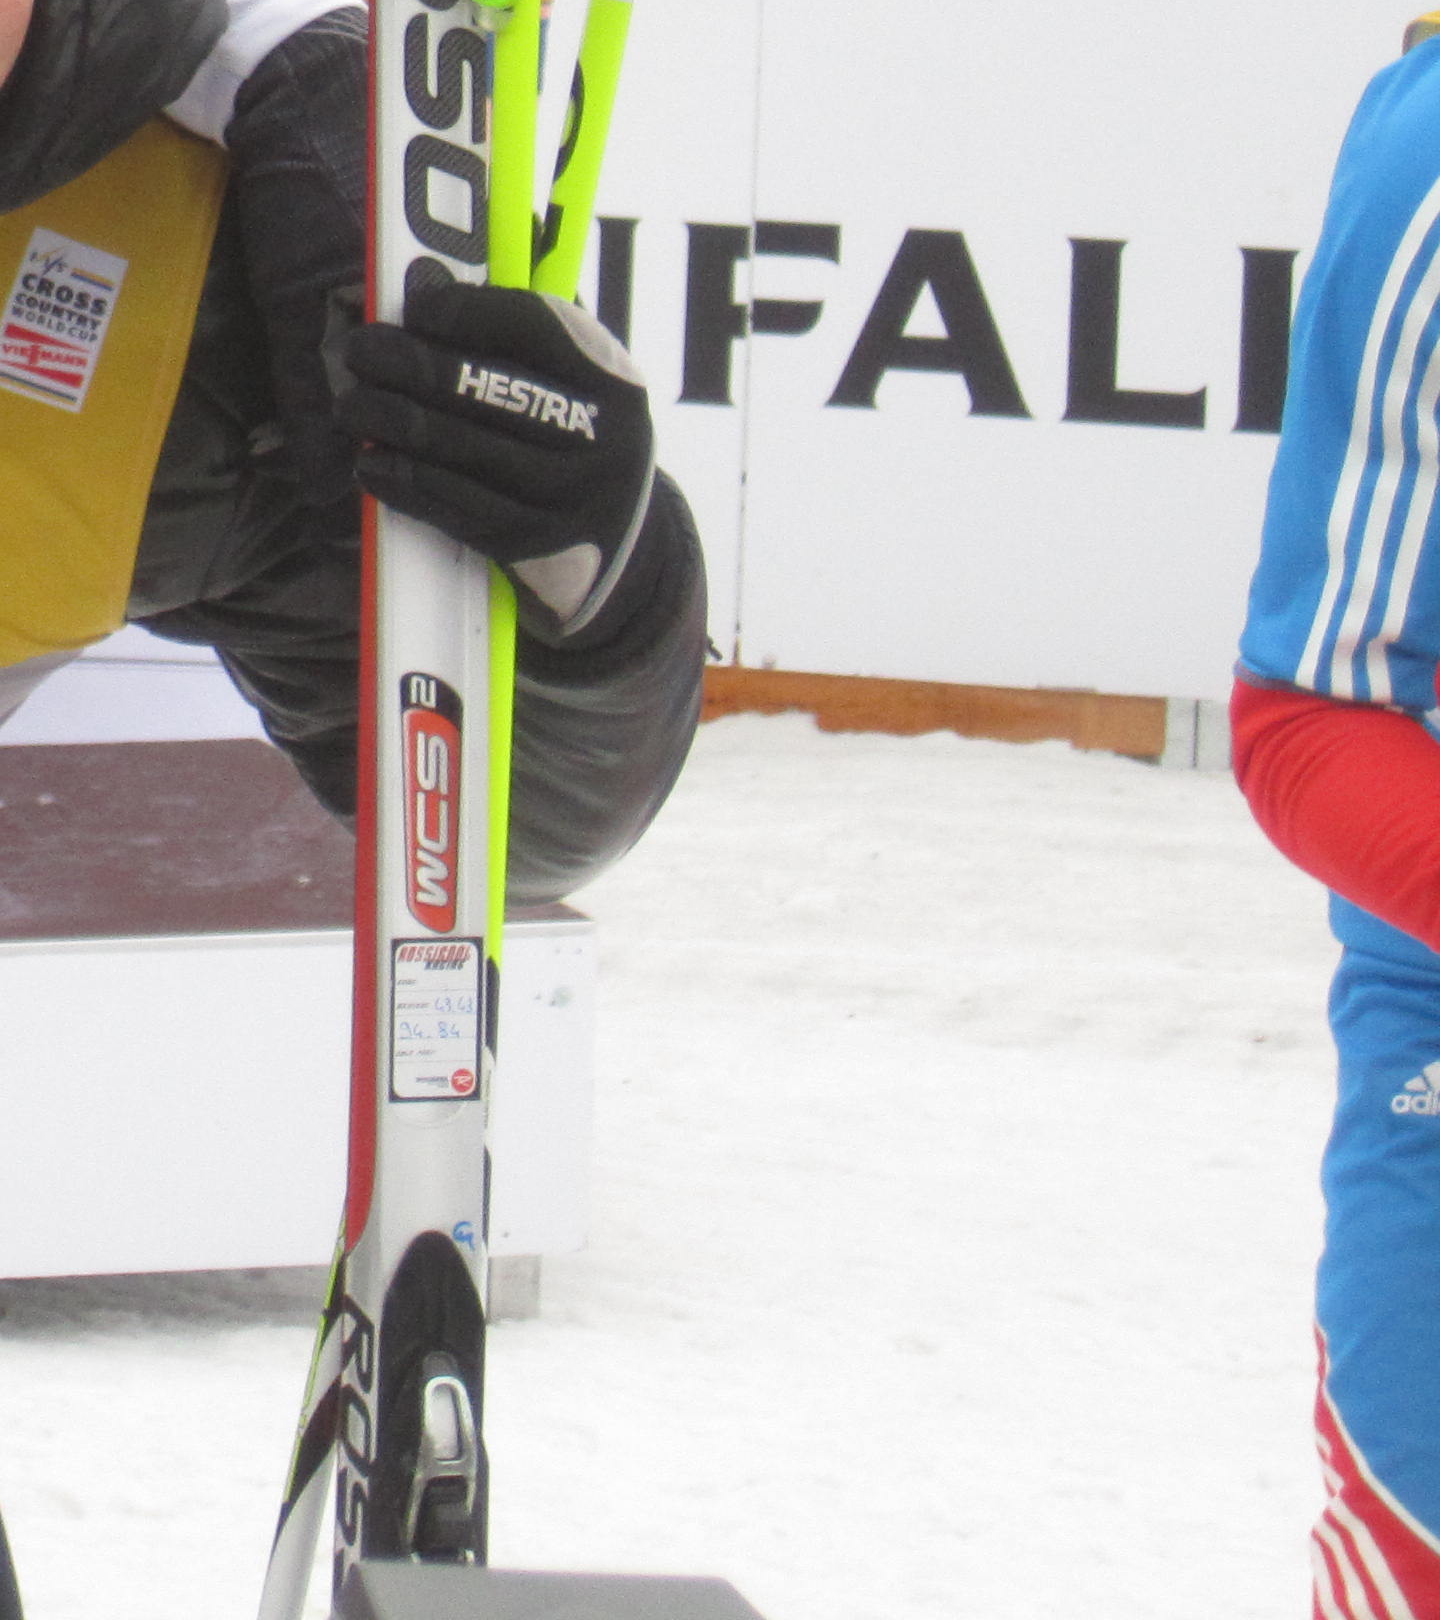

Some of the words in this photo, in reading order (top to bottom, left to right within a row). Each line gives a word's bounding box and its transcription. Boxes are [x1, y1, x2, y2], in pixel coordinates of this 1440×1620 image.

[16, 292, 102, 331] COUNTRY
[21, 273, 108, 316] CROSS
[11, 306, 66, 333] WORLD
[68, 325, 98, 343] CUP
[456, 362, 595, 440] HESTRA
[416, 731, 451, 908] WCS
